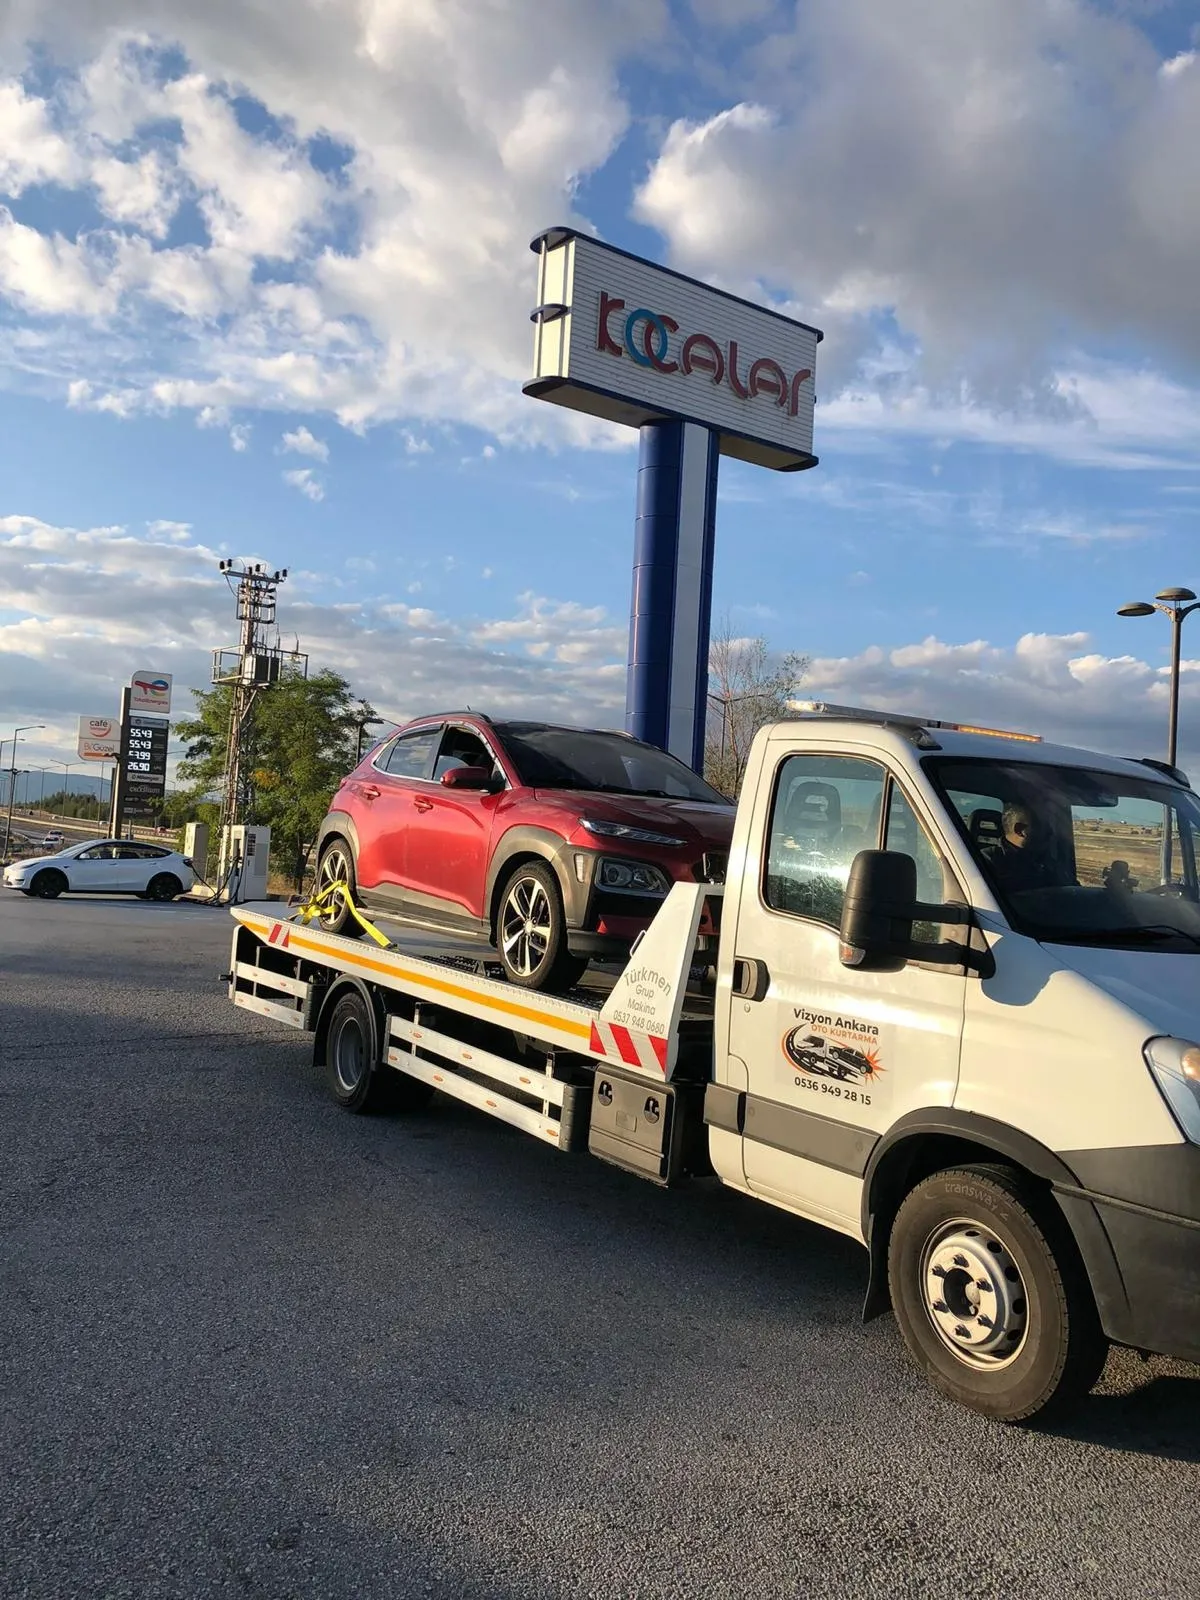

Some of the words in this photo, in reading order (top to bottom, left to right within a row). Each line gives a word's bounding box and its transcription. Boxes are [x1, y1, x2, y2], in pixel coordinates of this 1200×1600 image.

[89, 719, 108, 728] café
[130, 728, 152, 738] 55.43
[129, 740, 151, 749] 55.43
[127, 761, 150, 772] 26.90
[624, 966, 672, 996] Türkmen
[635, 984, 655, 1000] Grup
[627, 998, 656, 1015] Makina
[613, 1010, 630, 1024] 0537
[631, 1015, 645, 1029] 948
[793, 1008, 832, 1025] Vizyon
[835, 1017, 879, 1036] Ankara
[811, 1024, 828, 1034] OTO
[830, 1027, 877, 1045] KURTARMA
[794, 1076, 819, 1091] 0536
[821, 1084, 841, 1097] 949
[844, 1089, 857, 1102] 28
[860, 1093, 871, 1106] 15
[944, 1182, 998, 1211] transway
